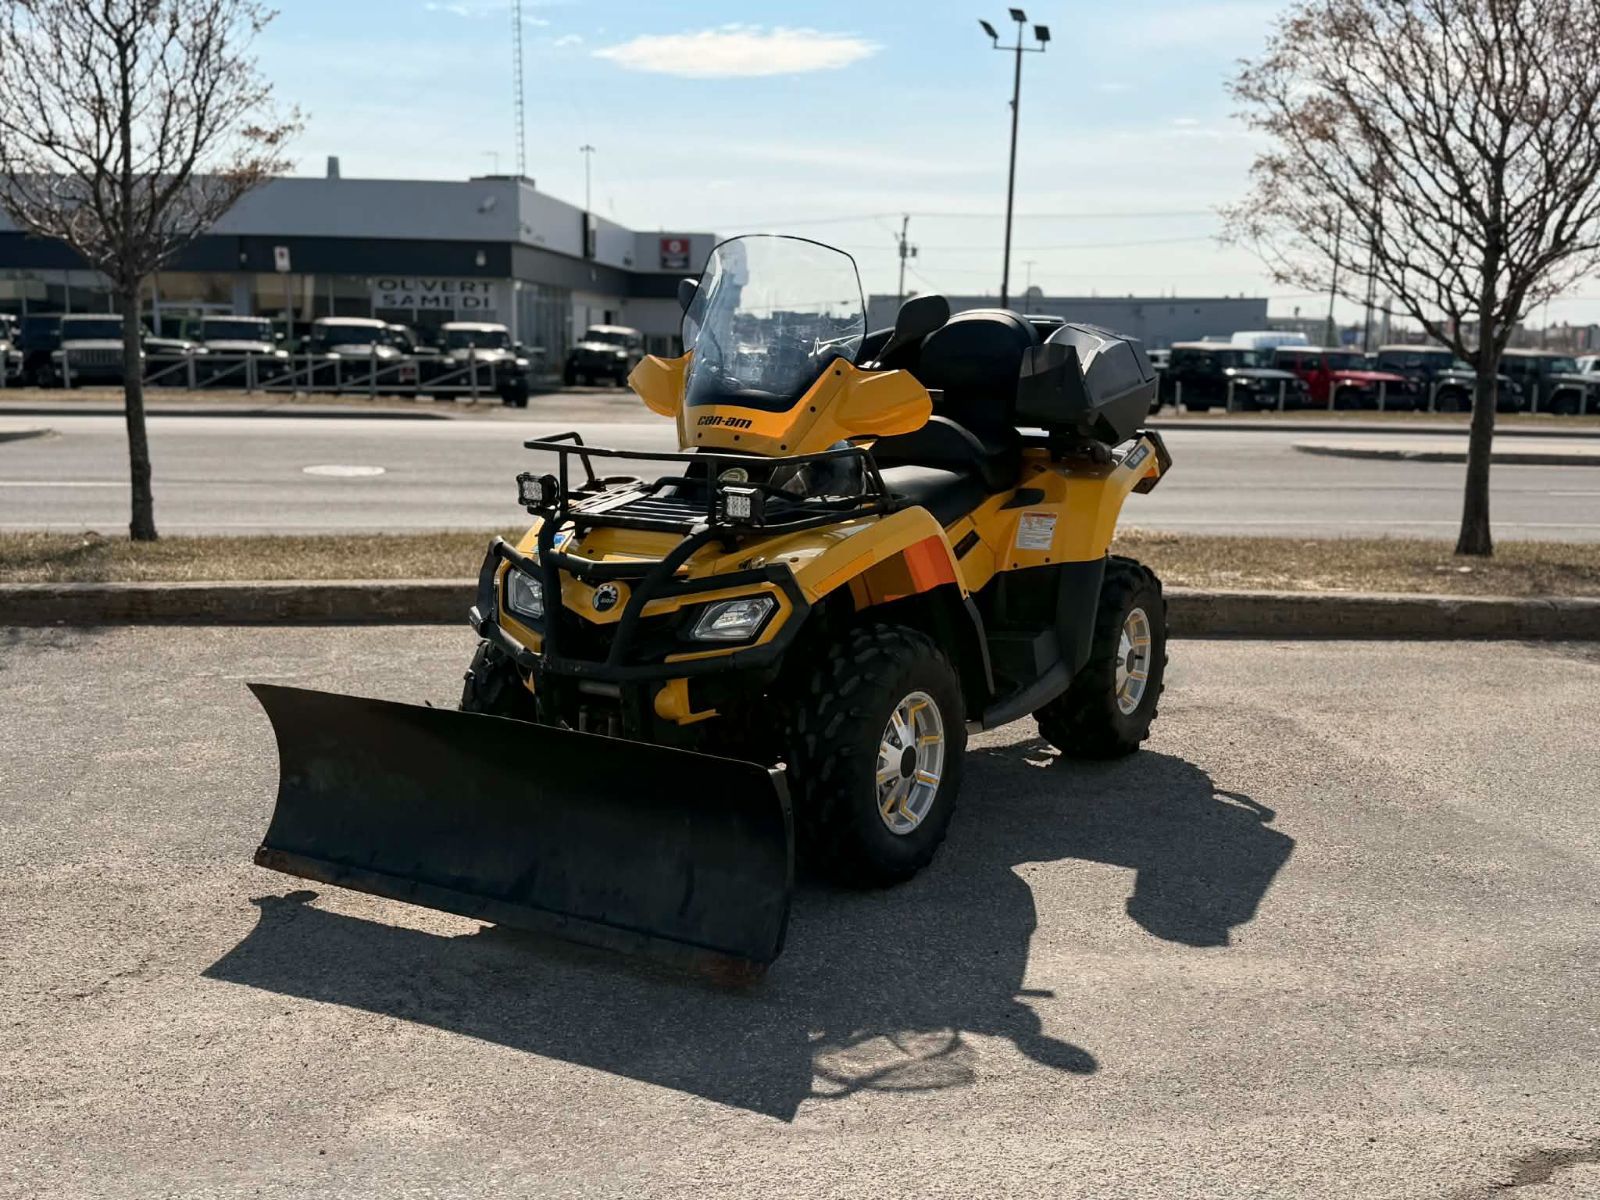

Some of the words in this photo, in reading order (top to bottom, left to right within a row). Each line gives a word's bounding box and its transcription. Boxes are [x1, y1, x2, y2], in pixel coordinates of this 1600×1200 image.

[378, 279, 494, 293] OUVERT
[382, 294, 490, 308] SAMEDI
[697, 415, 753, 429] can-am
